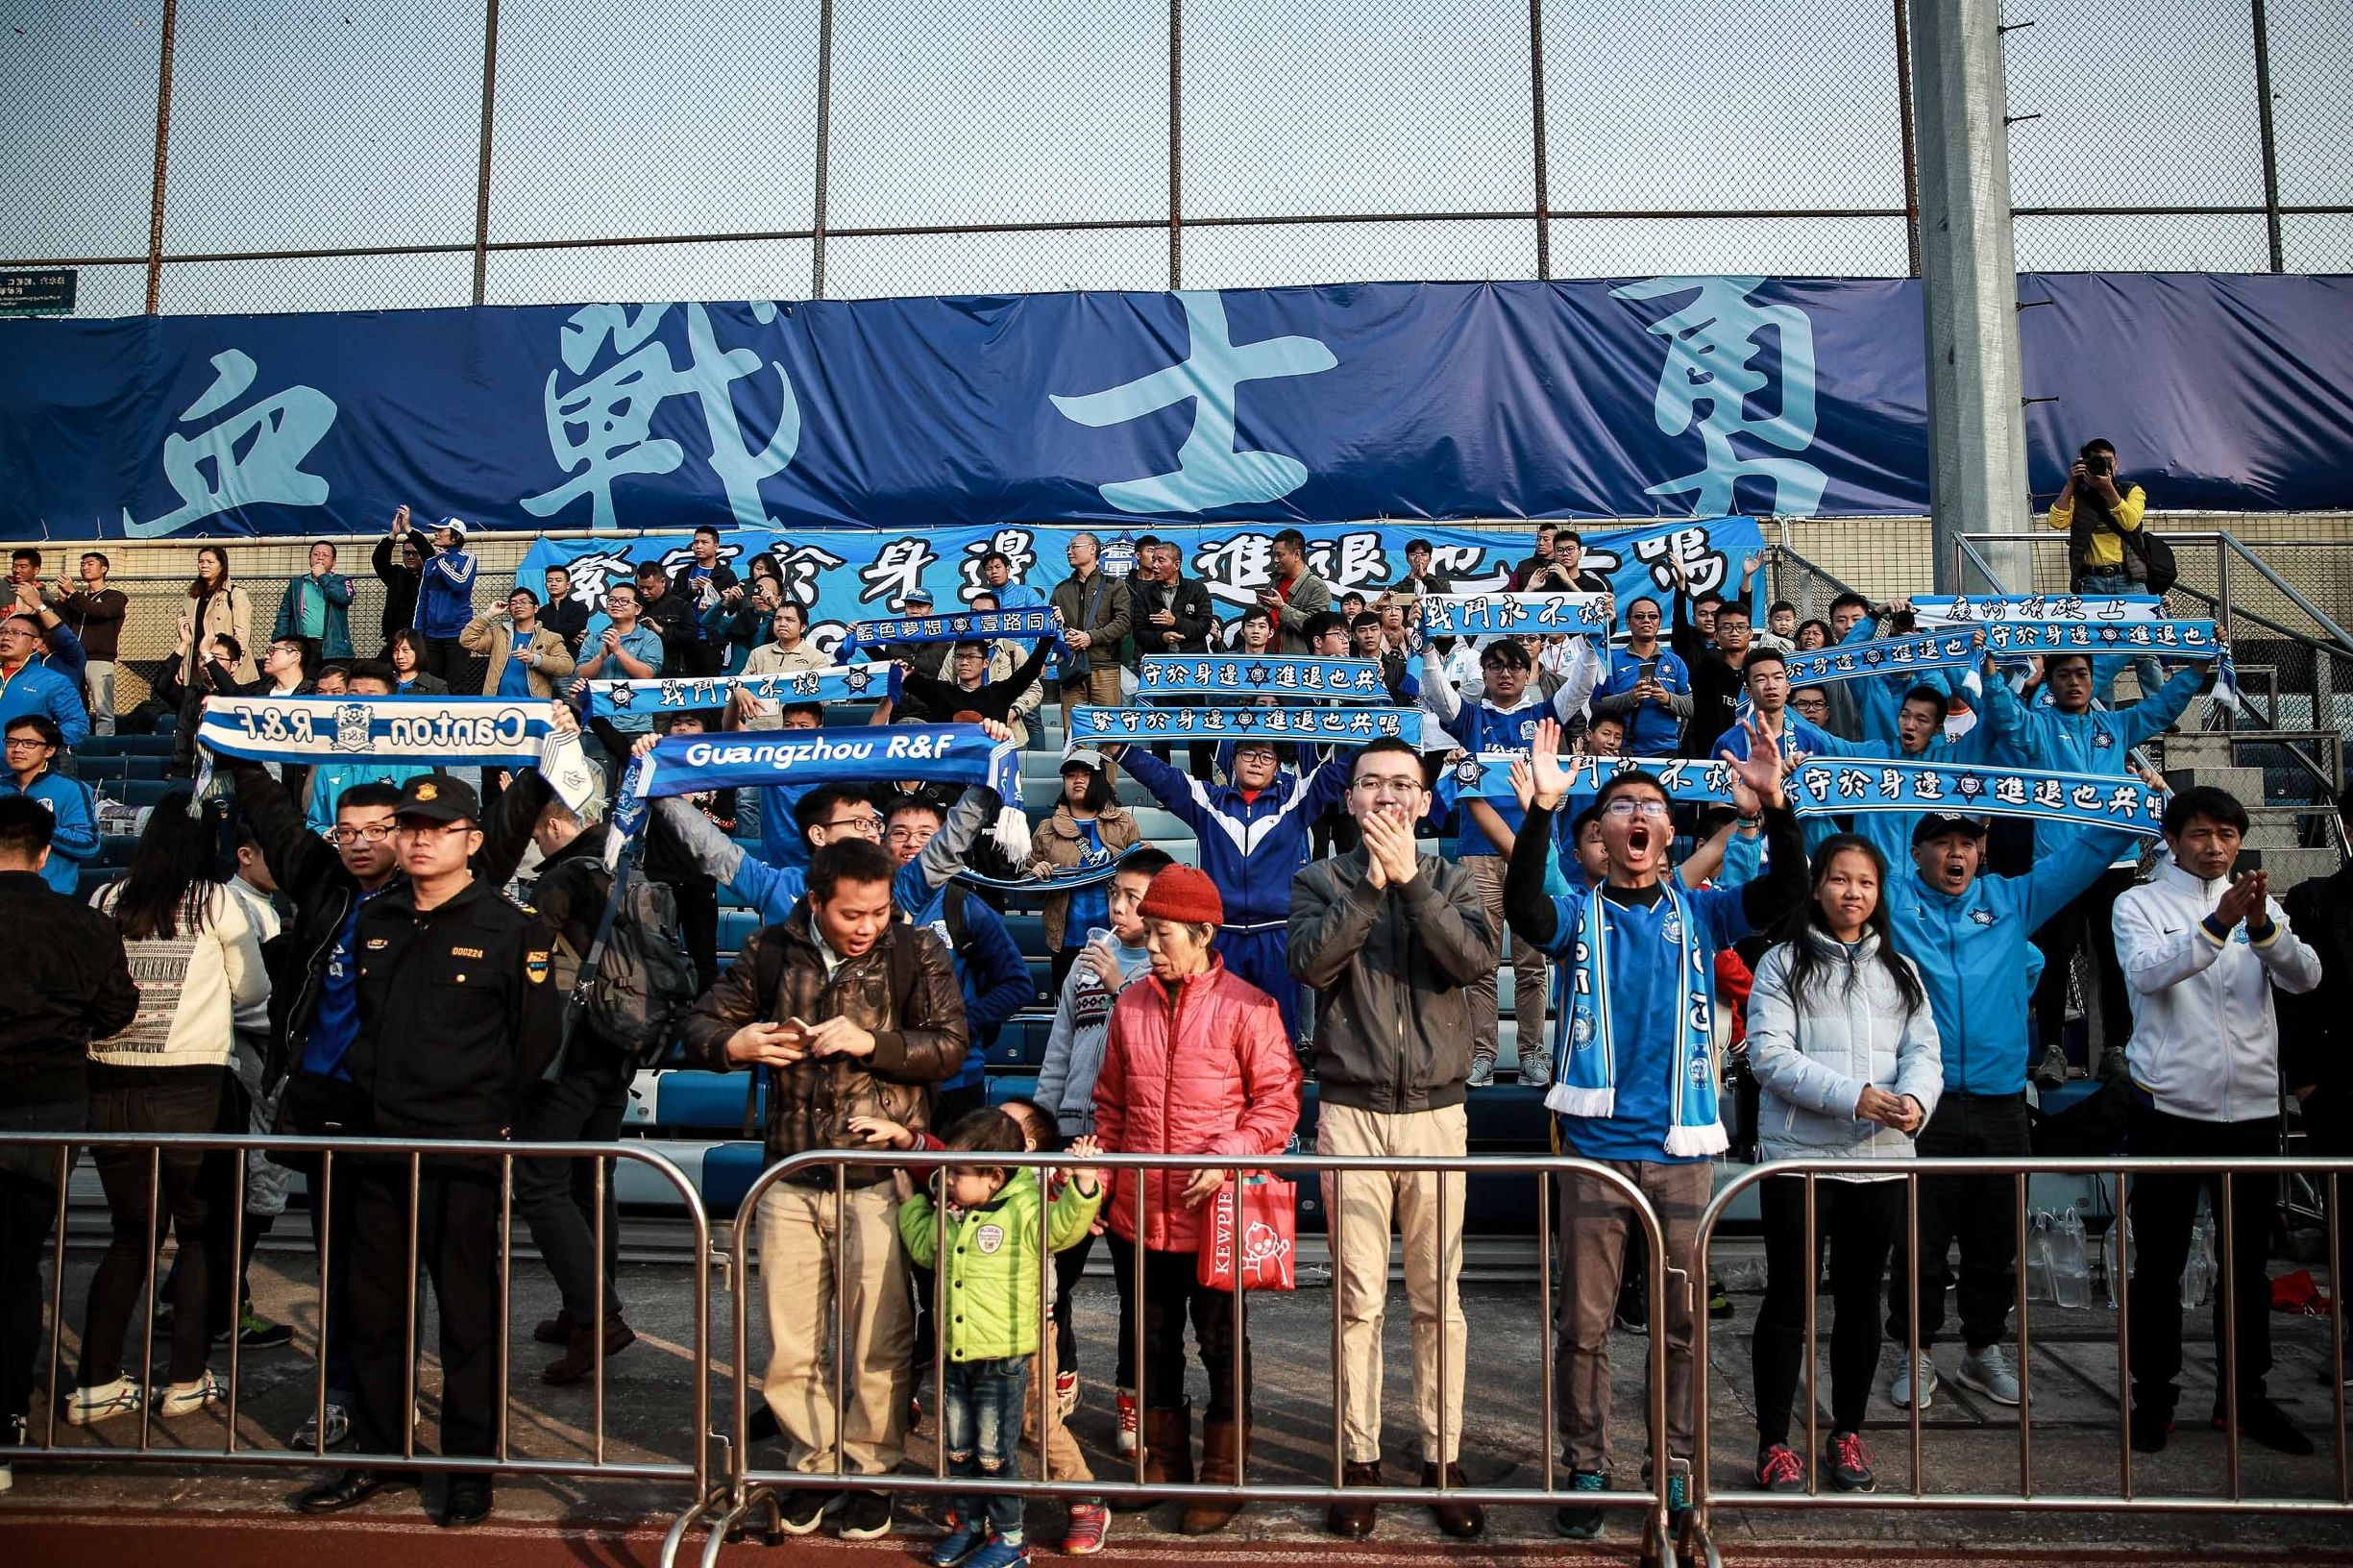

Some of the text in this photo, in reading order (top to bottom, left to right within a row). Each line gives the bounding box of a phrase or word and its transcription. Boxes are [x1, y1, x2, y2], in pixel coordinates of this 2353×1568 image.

[856, 619, 943, 642] 藍色夢想
[1091, 709, 1402, 737] 緊守於身邊 進退也共鳴
[685, 733, 956, 769] Guangzhou R&F
[981, 827, 997, 836] PUM
[1215, 1191, 1233, 1275] KEWPIE
